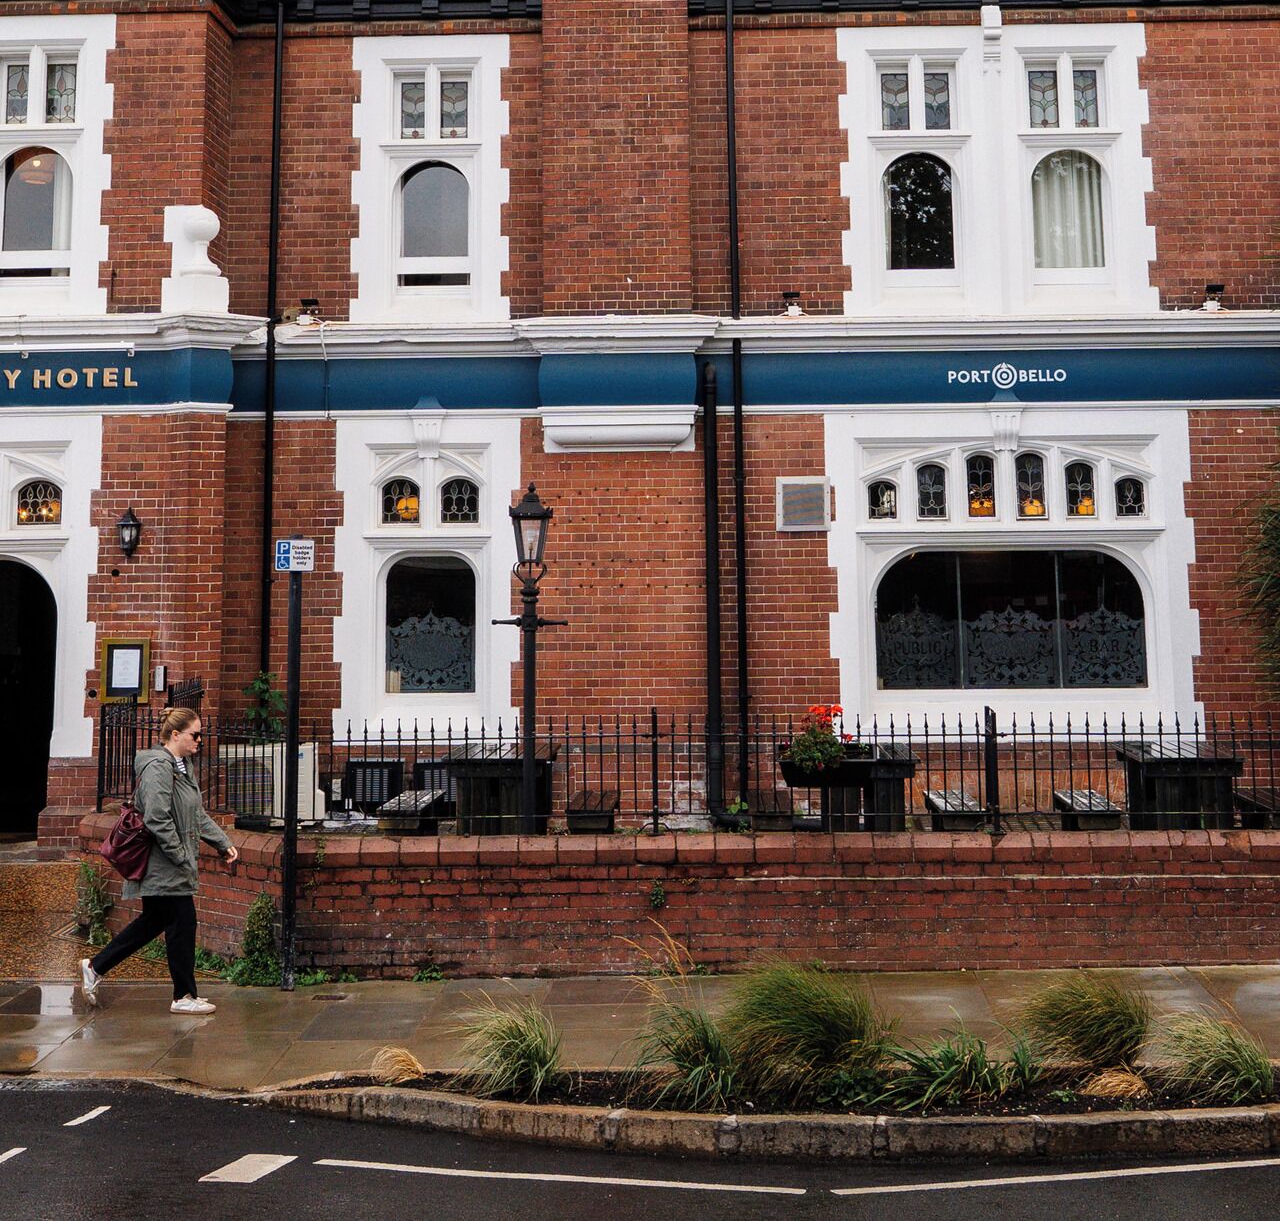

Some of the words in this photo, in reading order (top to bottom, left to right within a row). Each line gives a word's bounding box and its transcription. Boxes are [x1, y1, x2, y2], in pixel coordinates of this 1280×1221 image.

[33, 367, 138, 389] HOTEL
[280, 543, 289, 553] P
[894, 641, 942, 655] PUBLIC
[1089, 639, 1120, 653] BAR
